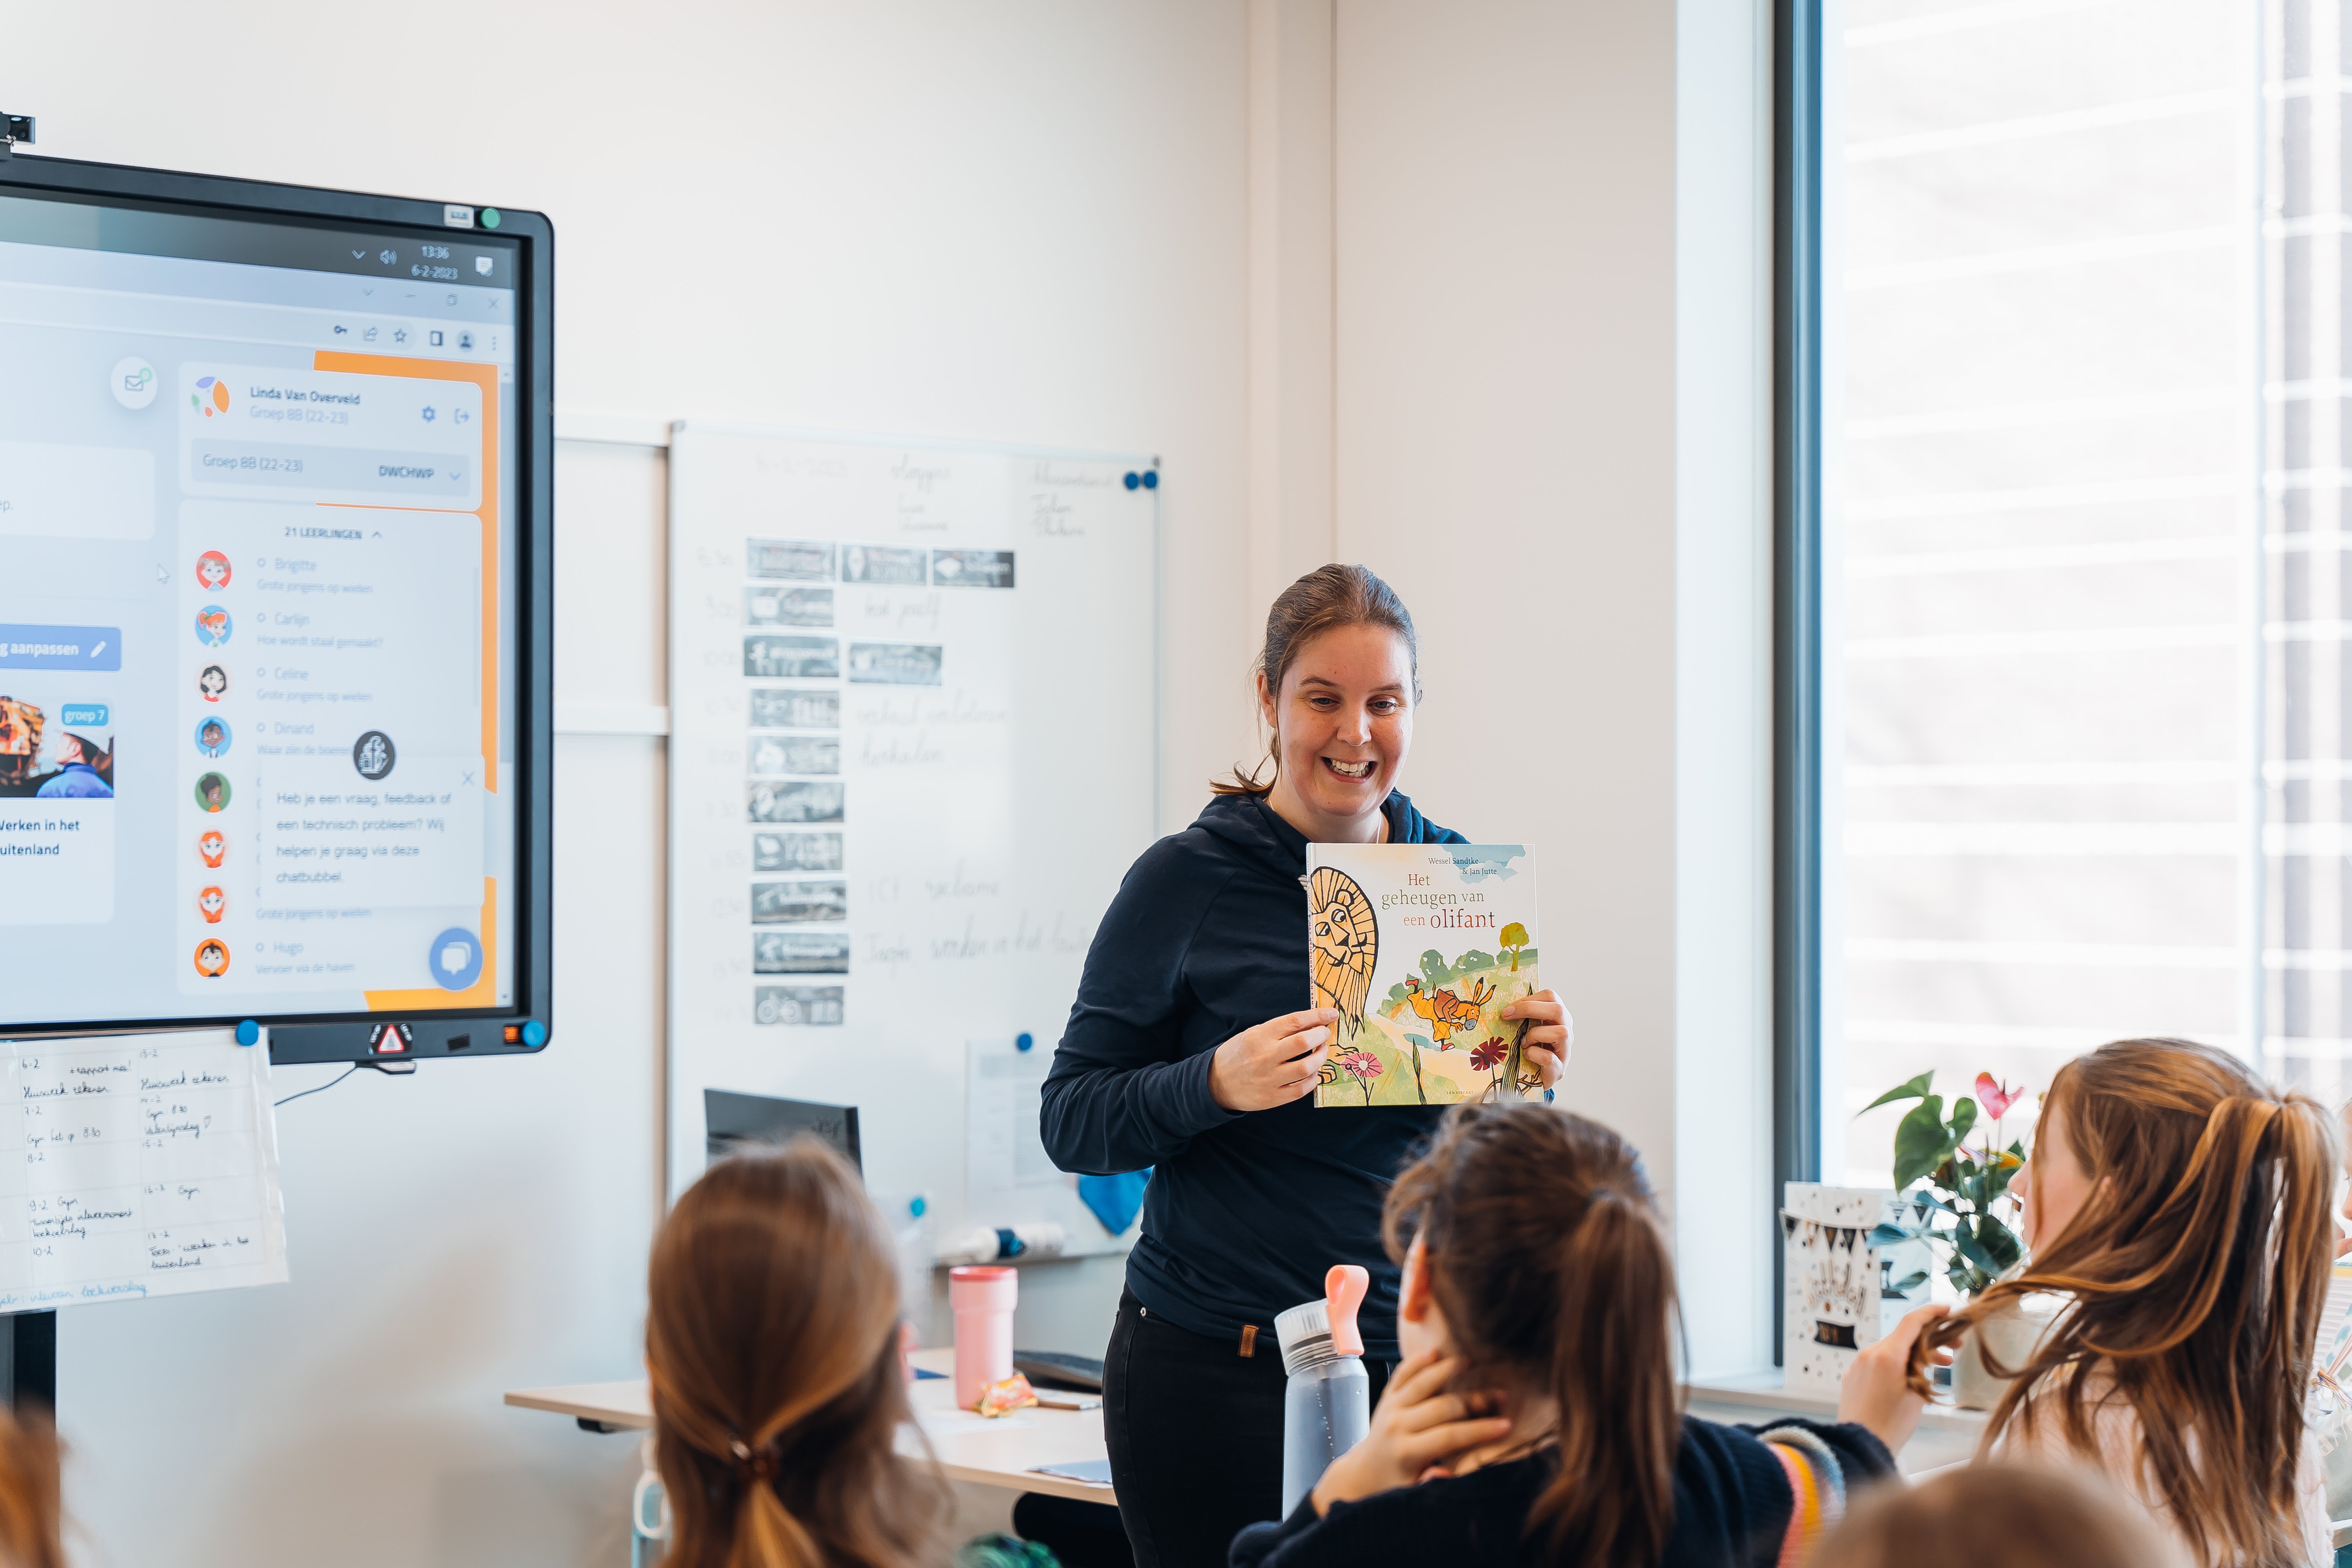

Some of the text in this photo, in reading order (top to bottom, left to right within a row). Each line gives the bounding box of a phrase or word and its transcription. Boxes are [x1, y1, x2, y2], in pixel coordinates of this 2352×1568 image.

[410, 263, 459, 280] 6-2-2023
[250, 386, 281, 400] Linda
[284, 389, 307, 402] Van
[250, 405, 283, 421] Groep
[305, 409, 348, 425] (22-23)
[203, 453, 238, 470] Groep
[259, 457, 303, 474] (22-23)
[284, 527, 363, 540] 21 LEERLINGEN
[274, 557, 317, 574] Brigitte
[274, 612, 310, 628] Carlijn
[10, 642, 79, 658] aanpassen
[274, 667, 309, 681] Celine
[65, 709, 105, 723] groep 7
[274, 722, 315, 735] Dinand
[277, 792, 301, 804] Heb
[304, 792, 316, 807] je
[319, 794, 341, 804] een
[384, 792, 436, 804] feedback
[440, 792, 452, 804] of
[45, 818, 56, 831] in
[60, 819, 81, 831] het
[276, 818, 445, 834] een technisch probleem? Wij
[0, 843, 60, 856] uitenland
[276, 845, 420, 860] helpen je graag via deze
[1408, 873, 1430, 886] Het
[1382, 890, 1485, 909] geheugen van
[1403, 909, 1496, 929] een olifant
[273, 942, 304, 957] Hugo
[58, 1195, 78, 1211] Gym
